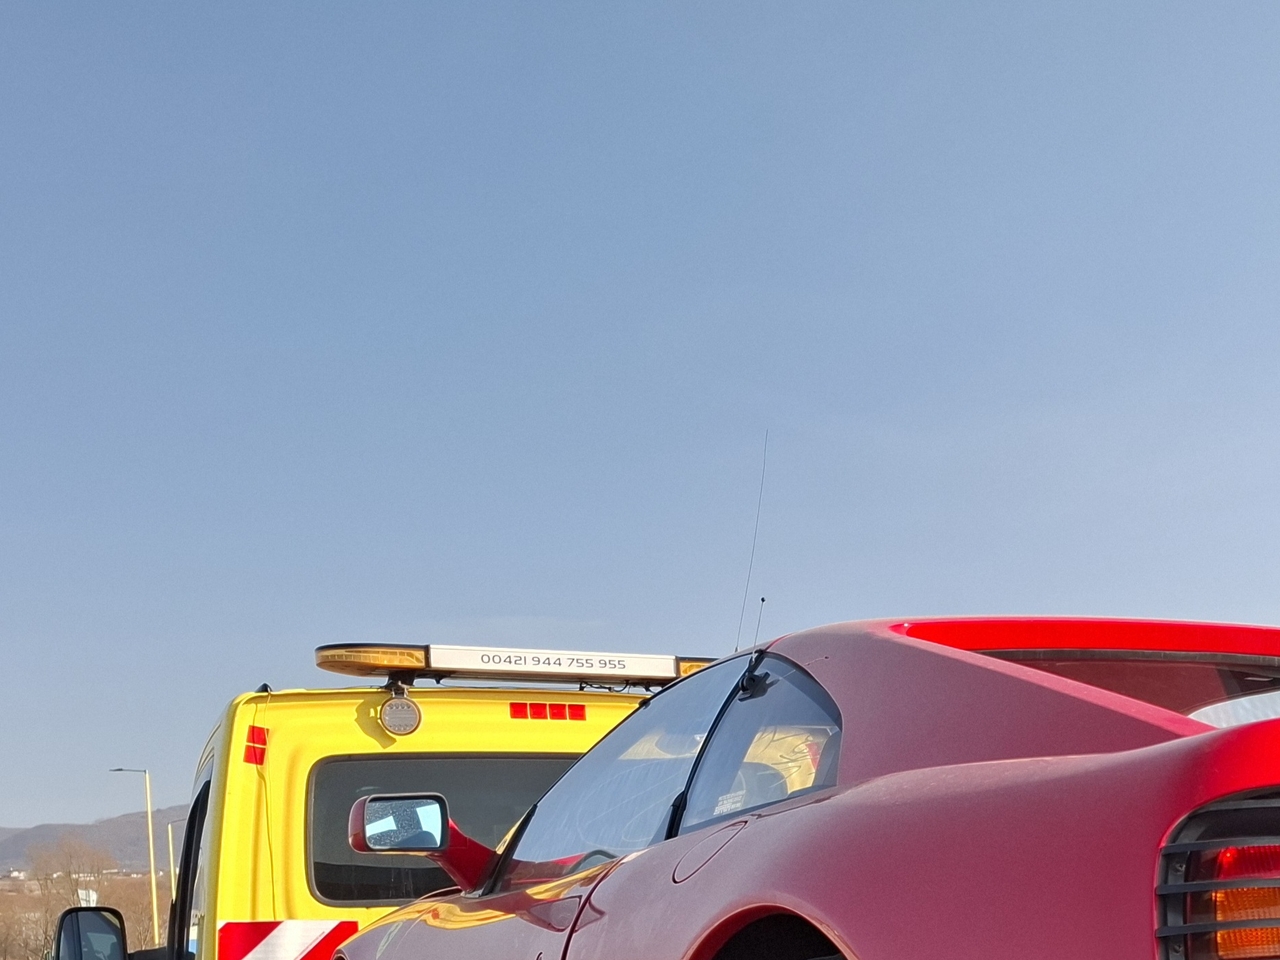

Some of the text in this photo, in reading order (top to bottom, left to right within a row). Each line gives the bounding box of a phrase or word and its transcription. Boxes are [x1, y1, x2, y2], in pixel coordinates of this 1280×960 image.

[480, 653, 626, 670] 00421 944 755 955
